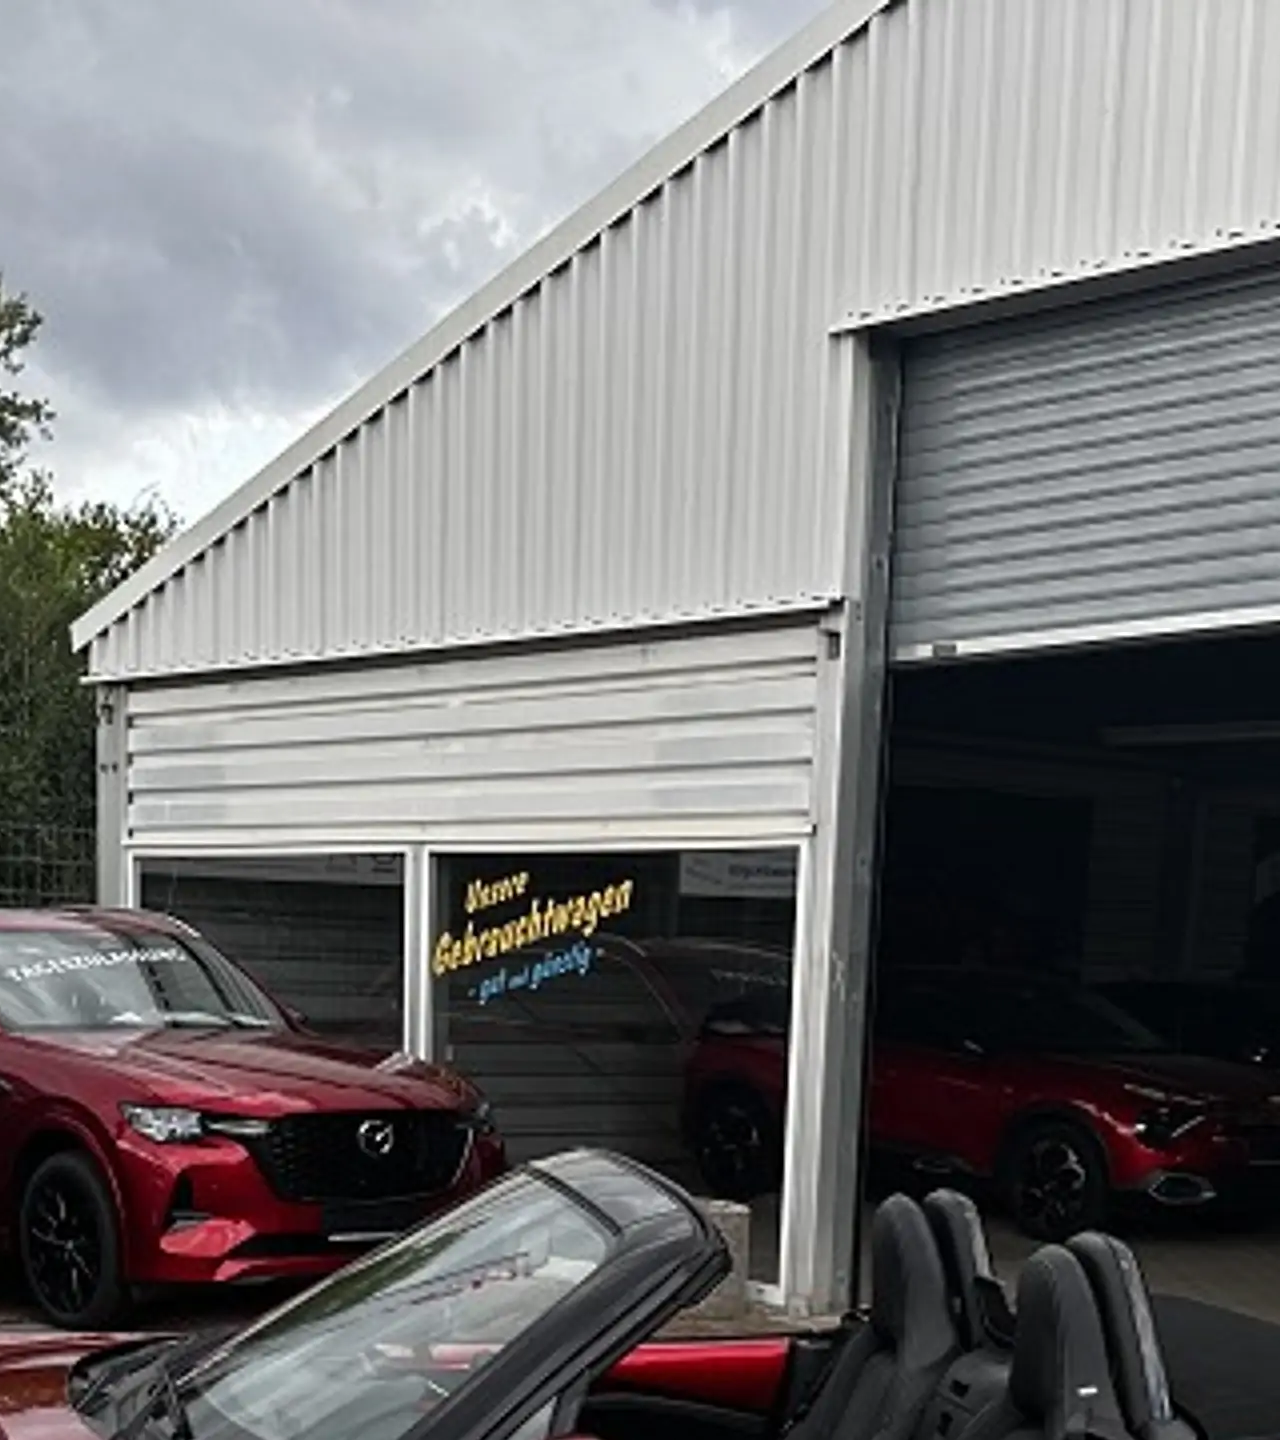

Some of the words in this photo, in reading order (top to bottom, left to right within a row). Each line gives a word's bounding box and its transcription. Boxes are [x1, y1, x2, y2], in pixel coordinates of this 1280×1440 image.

[465, 871, 529, 913] Unsere
[432, 879, 634, 976] Gebrauchtwagen
[478, 968, 507, 1005] gut
[530, 940, 592, 989] günstig
